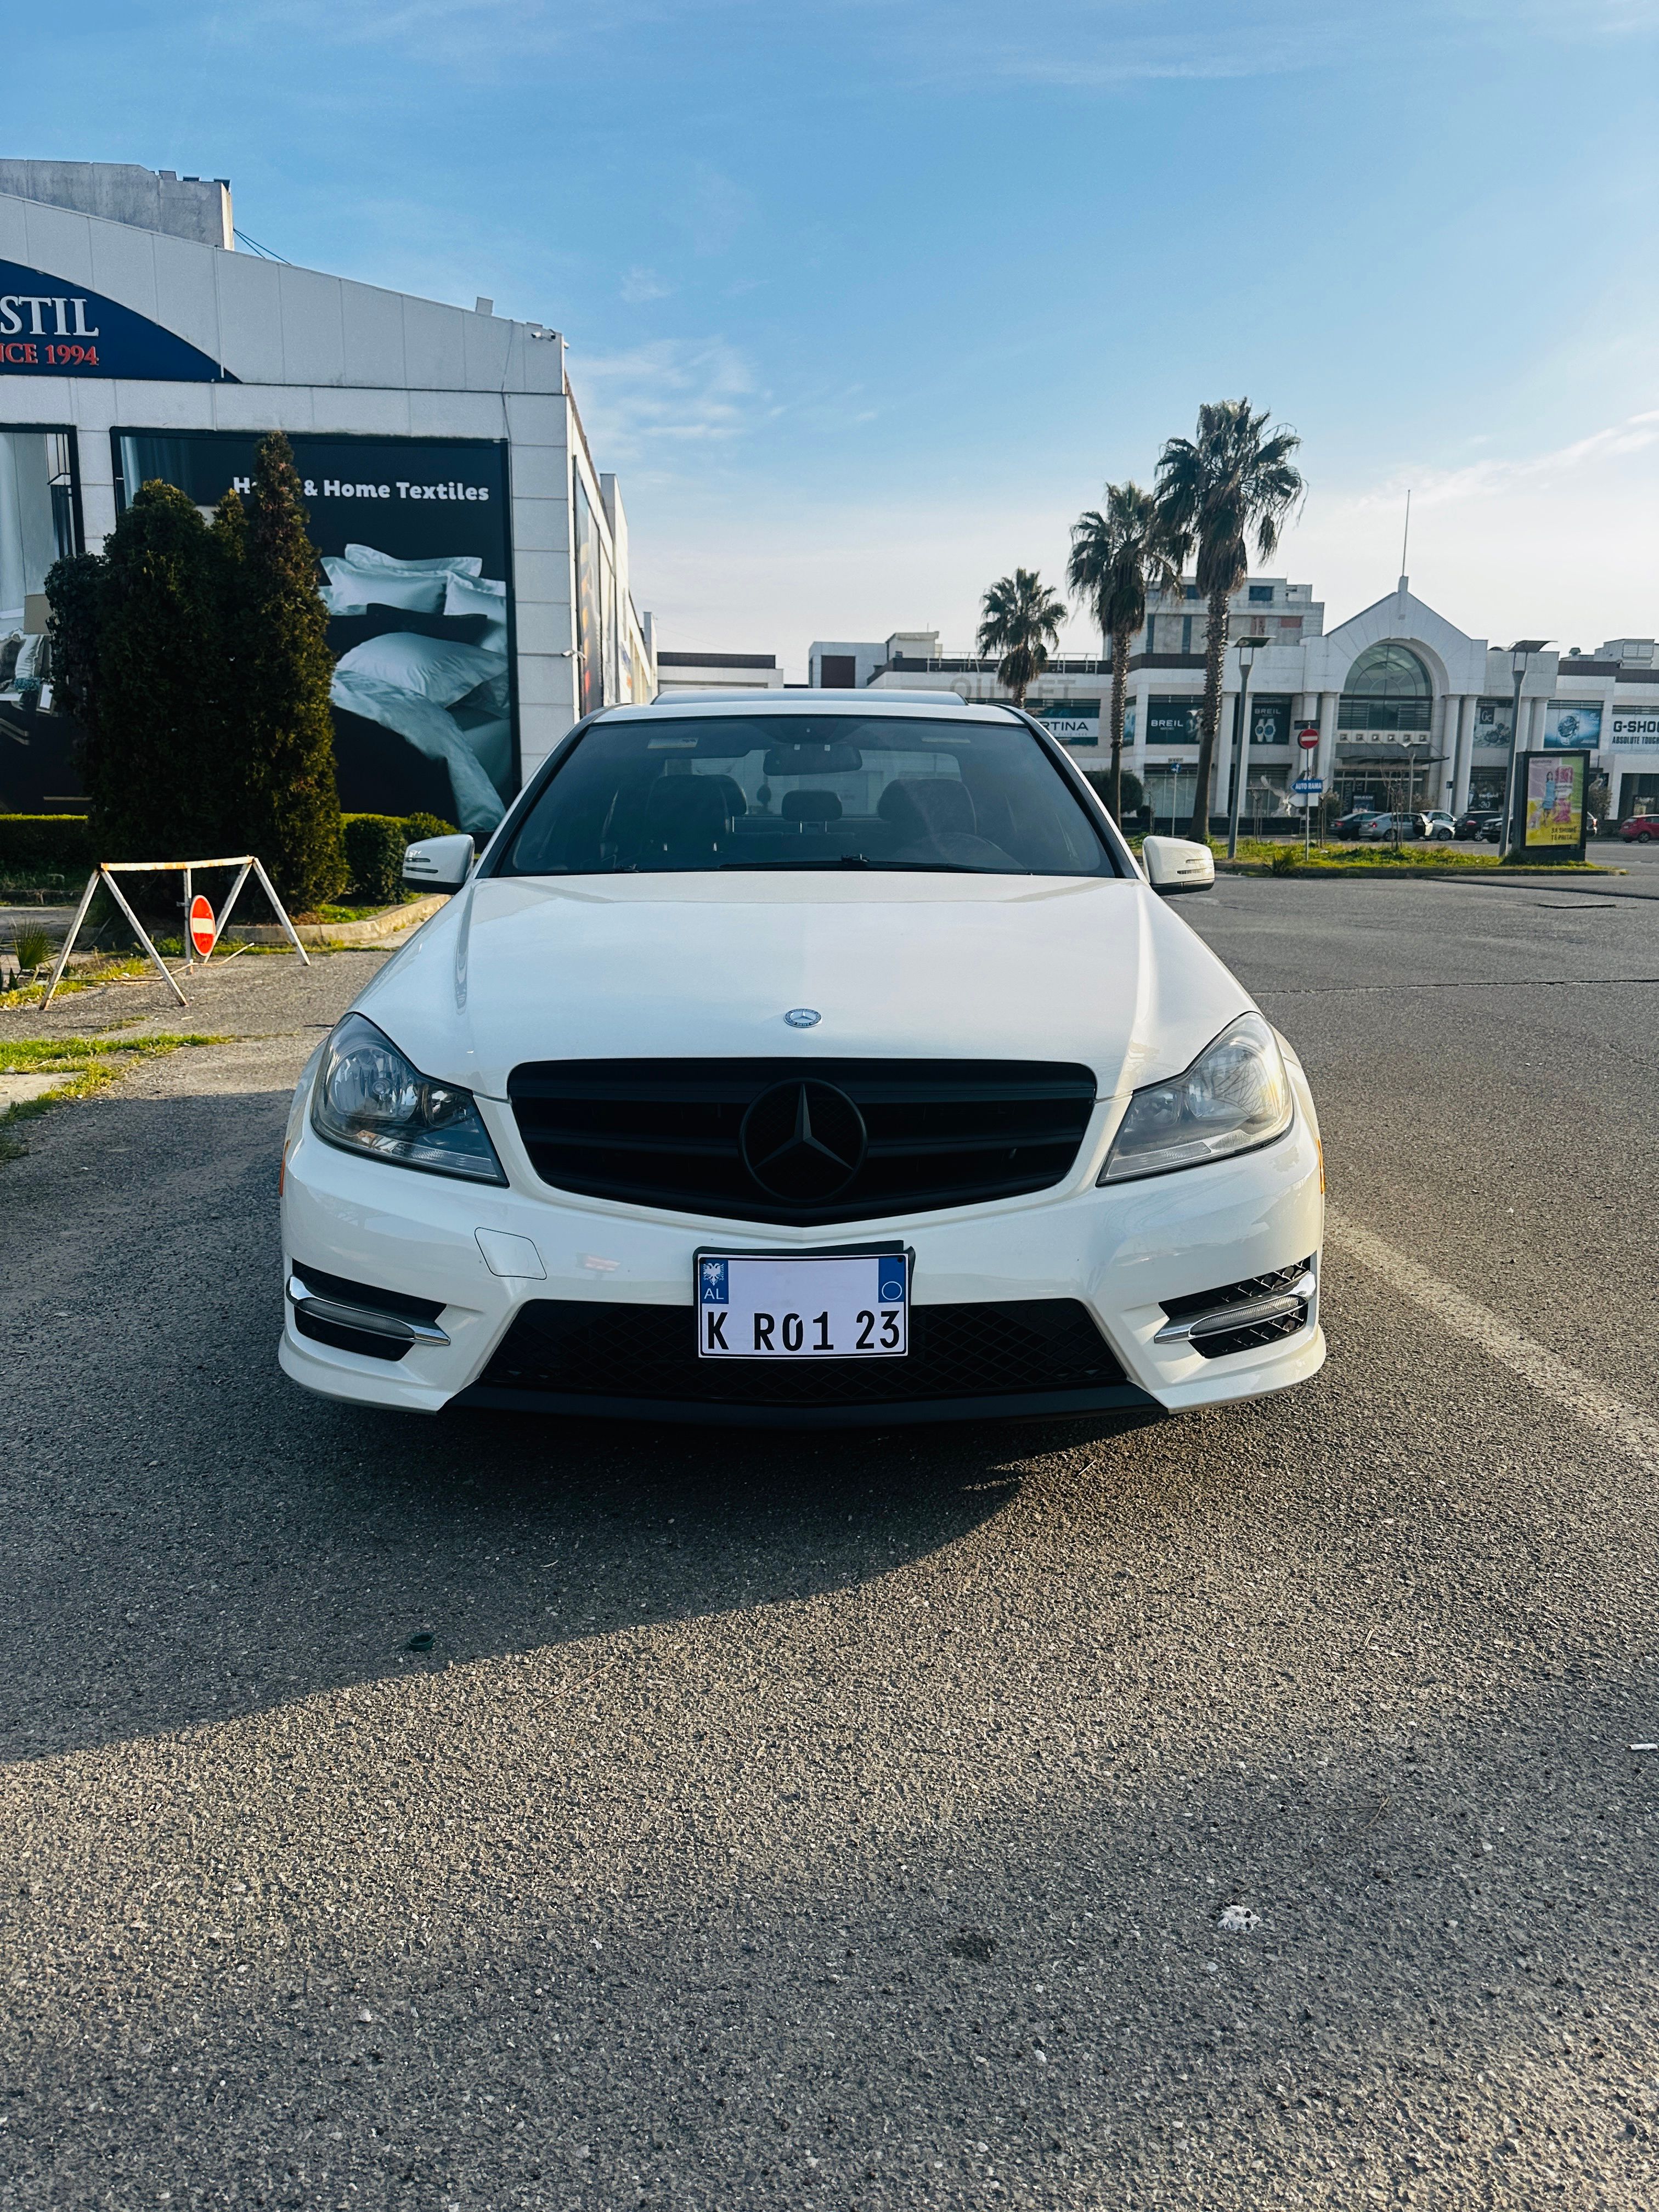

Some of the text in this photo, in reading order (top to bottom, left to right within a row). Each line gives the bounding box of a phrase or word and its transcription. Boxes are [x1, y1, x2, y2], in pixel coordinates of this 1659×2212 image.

[44, 344, 99, 366] 1994
[304, 479, 489, 501] & Home Textiles
[950, 677, 1076, 698] OUET
[1039, 721, 1089, 731] RTINA
[1612, 736, 1640, 744] ABSOLUTE
[704, 1288, 724, 1300] AL
[708, 1311, 729, 1350] K
[856, 1310, 900, 1350] 23
